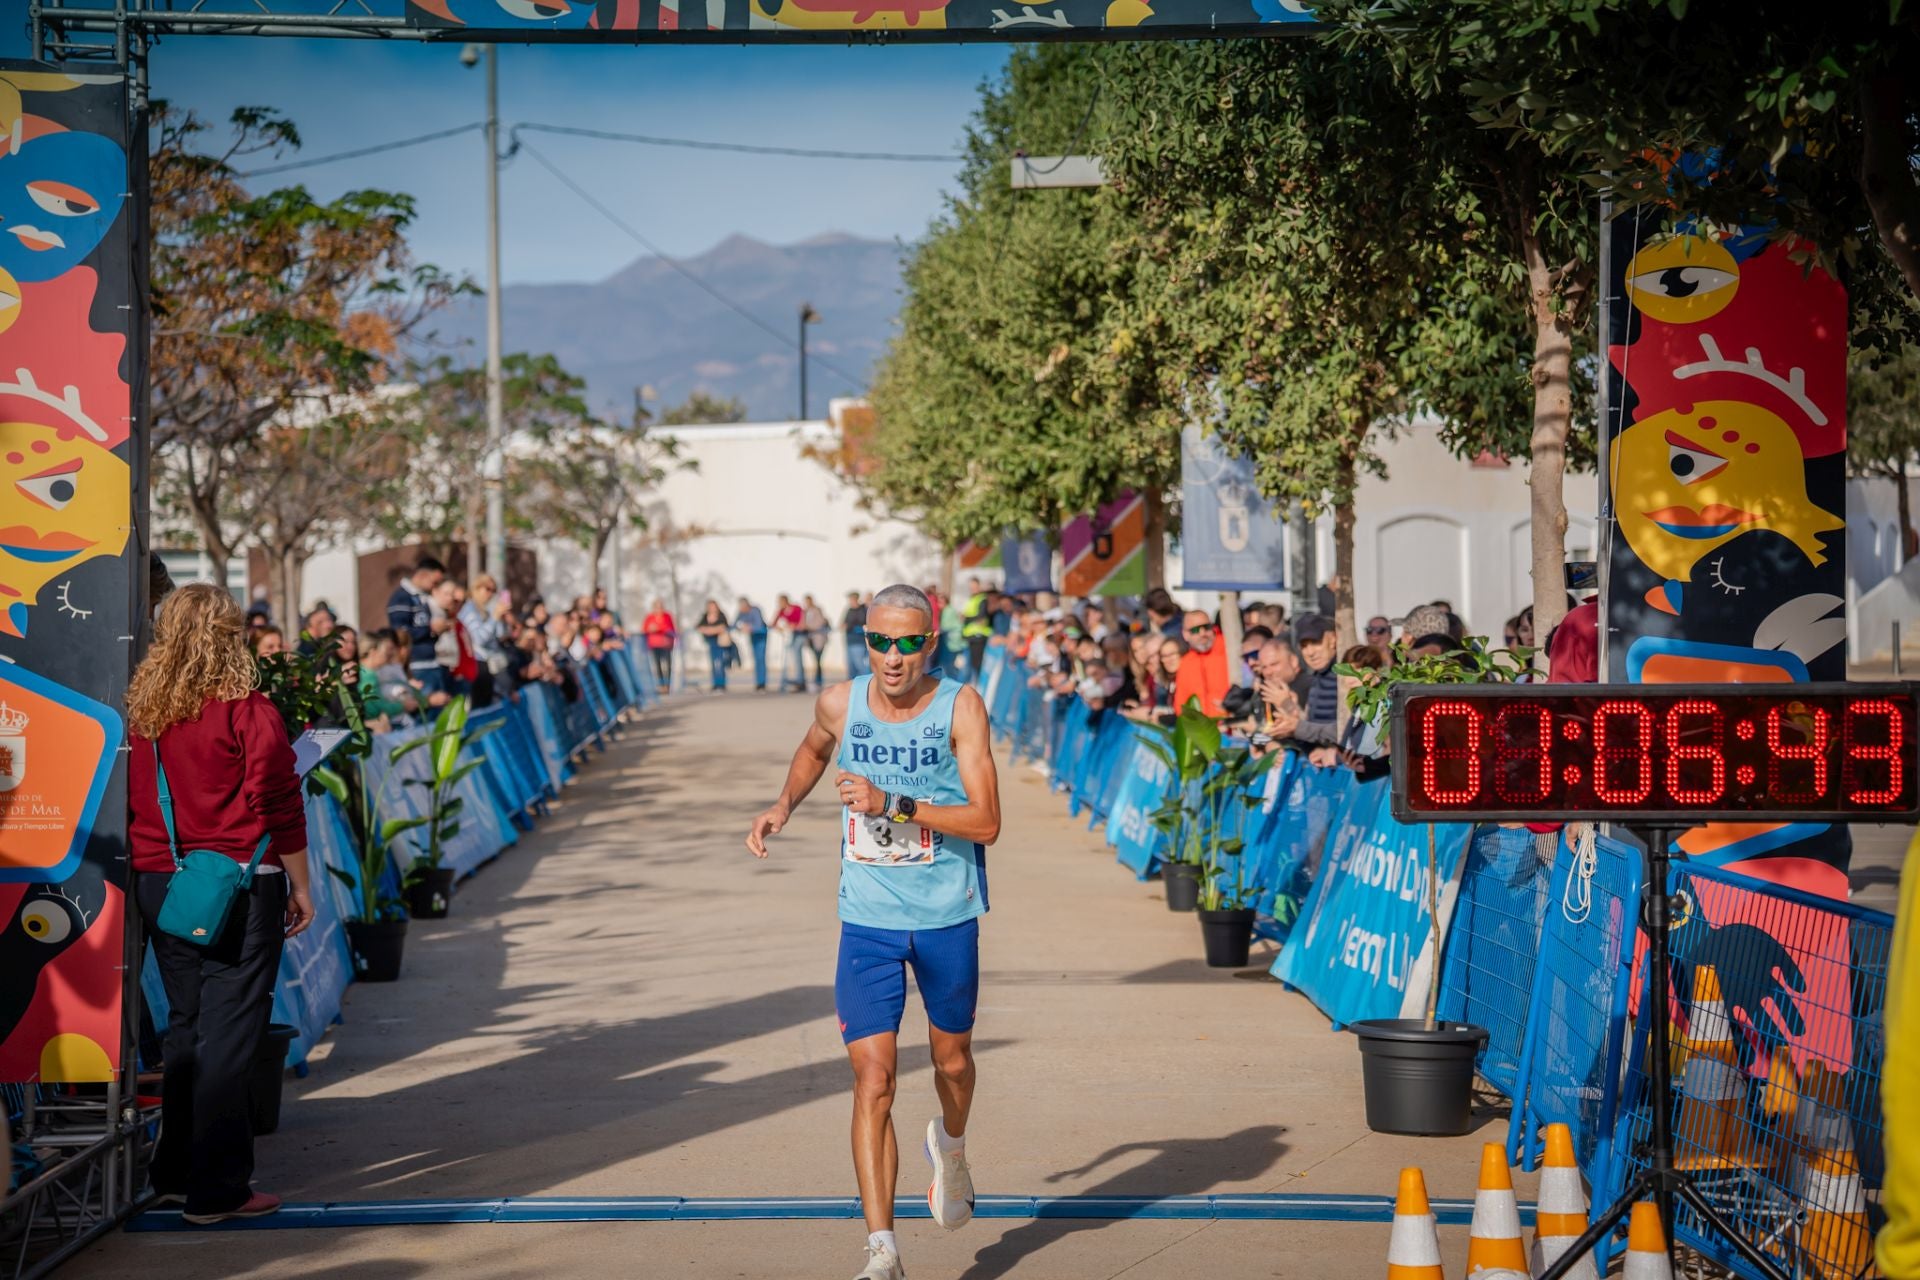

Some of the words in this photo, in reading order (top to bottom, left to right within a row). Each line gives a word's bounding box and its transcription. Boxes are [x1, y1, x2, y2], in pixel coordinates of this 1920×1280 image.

[851, 738, 939, 773] nerja
[1422, 699, 1903, 804] 01:06:43
[11, 805, 27, 815] DE
[24, 823, 48, 831] Tiempo
